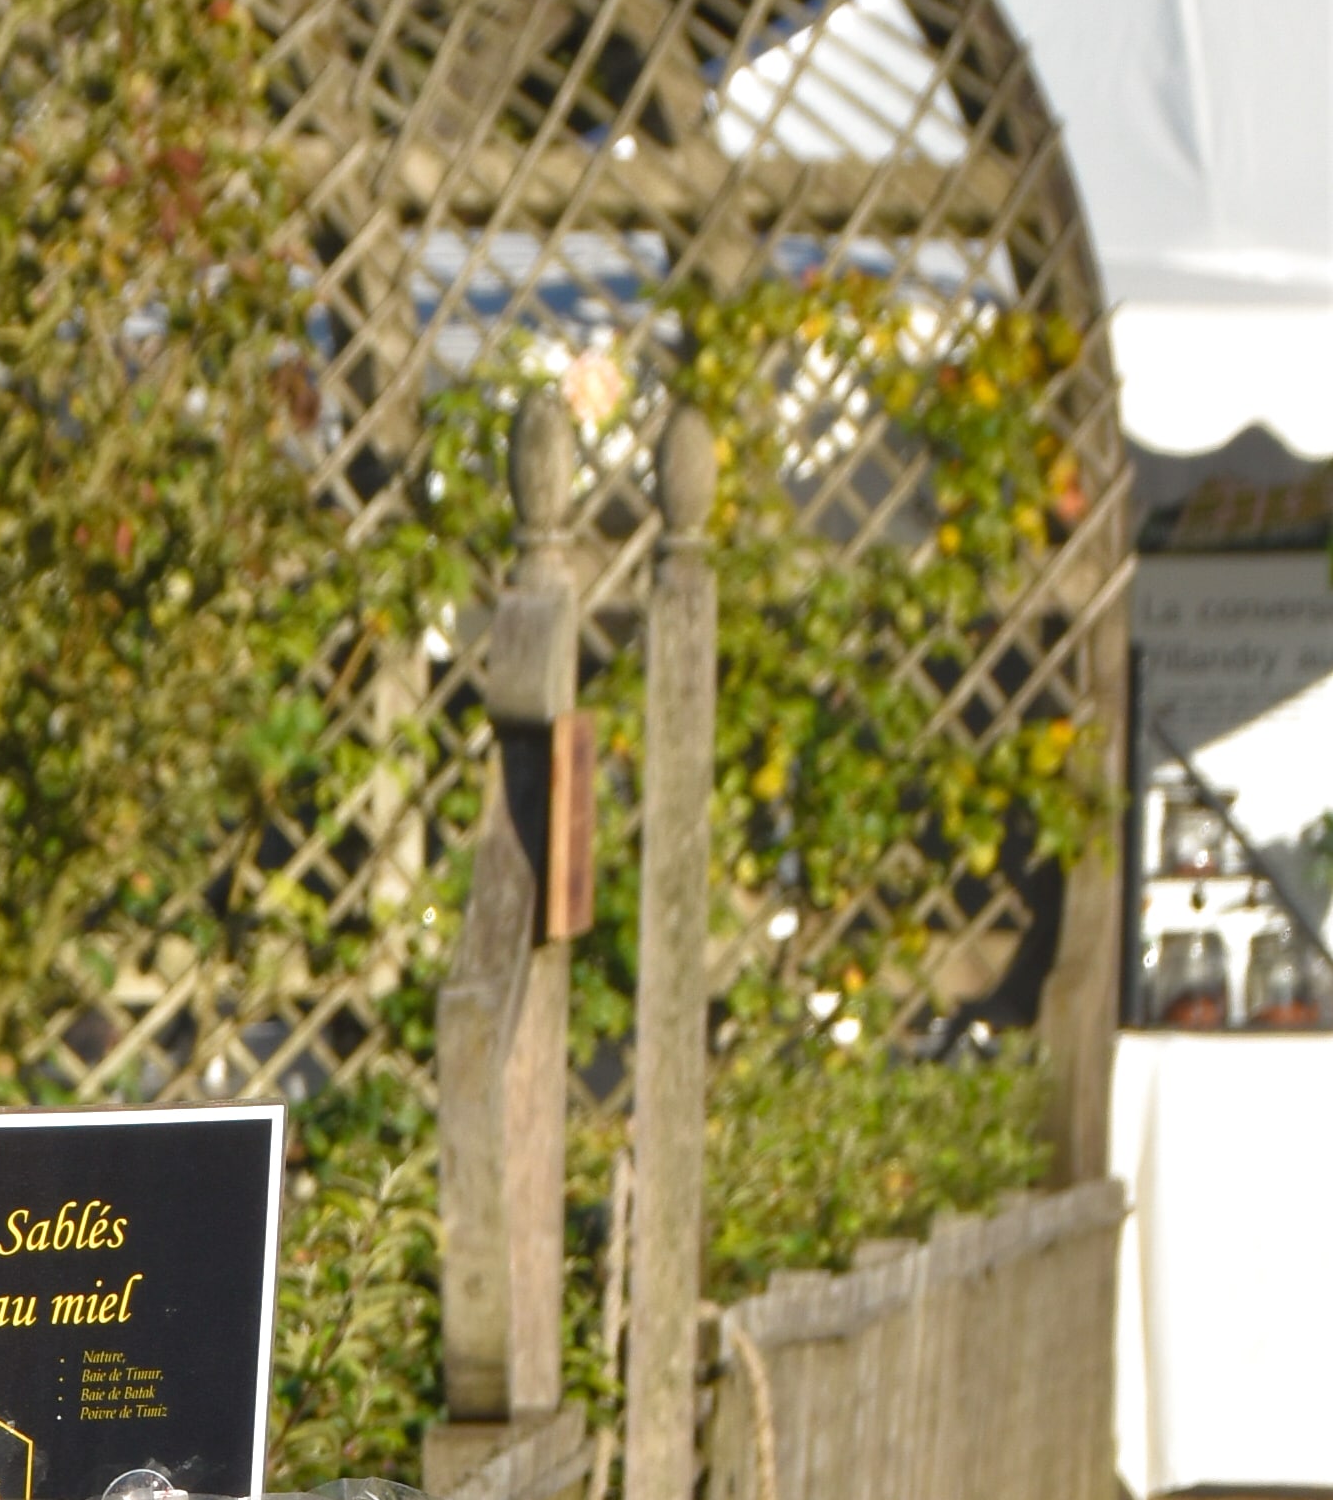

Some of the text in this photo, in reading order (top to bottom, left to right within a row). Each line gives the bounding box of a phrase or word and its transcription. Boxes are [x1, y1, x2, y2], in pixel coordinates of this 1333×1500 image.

[50, 1272, 144, 1326] miel
[82, 1349, 127, 1365] Nature,
[81, 1368, 107, 1384] Baie
[108, 1367, 123, 1382] de
[80, 1384, 156, 1402] Baie de Batak
[79, 1405, 118, 1421] Poivre
[119, 1404, 134, 1419] de
